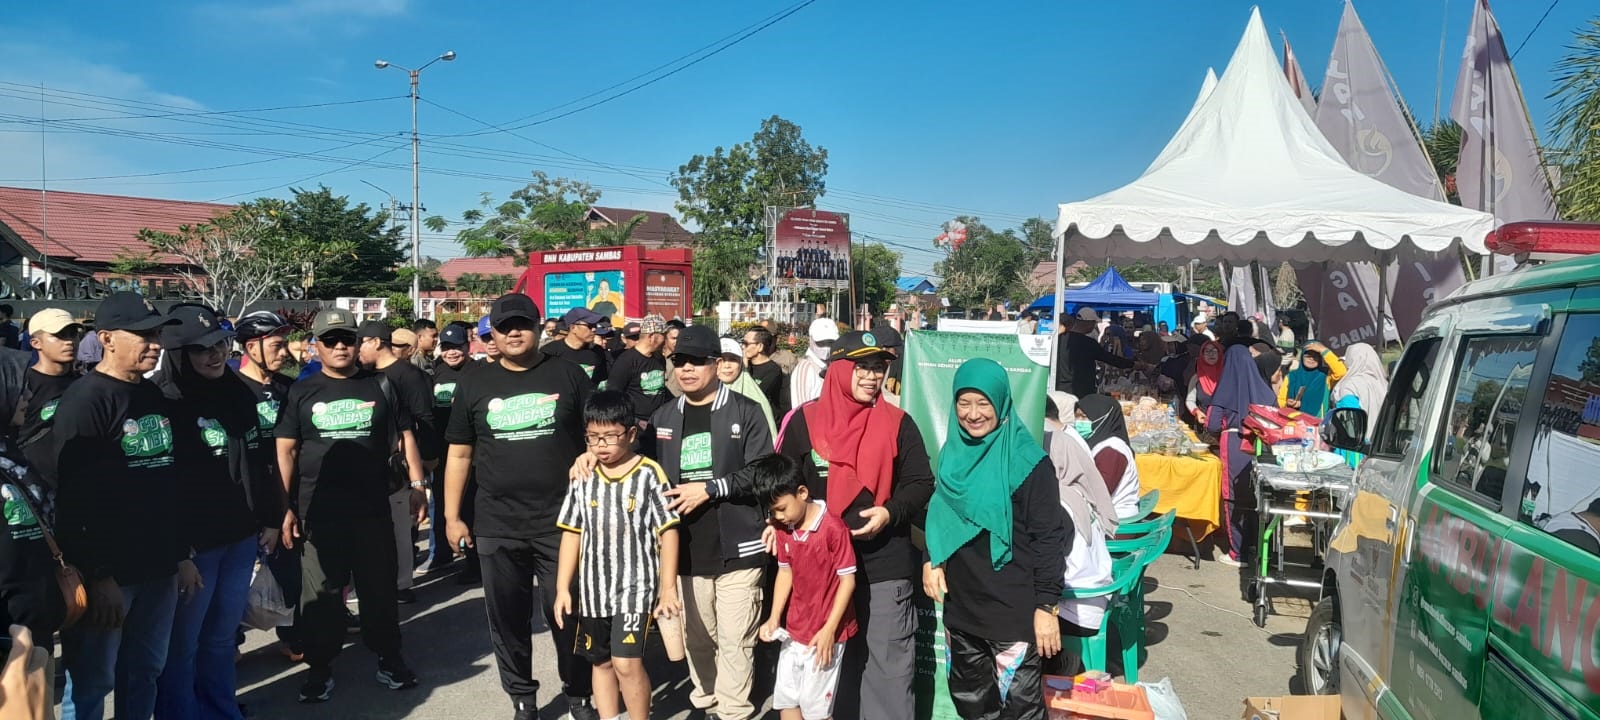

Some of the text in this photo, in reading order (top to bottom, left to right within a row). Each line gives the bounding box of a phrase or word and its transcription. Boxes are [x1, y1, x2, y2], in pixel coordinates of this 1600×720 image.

[558, 252, 594, 263] KABUPATEN
[594, 250, 622, 261] SAMBAS
[327, 400, 356, 414] CFD
[316, 411, 372, 429] SAMBAS
[489, 403, 556, 430] SAMBAS
[684, 433, 711, 451] CFD
[623, 613, 640, 631] 22
